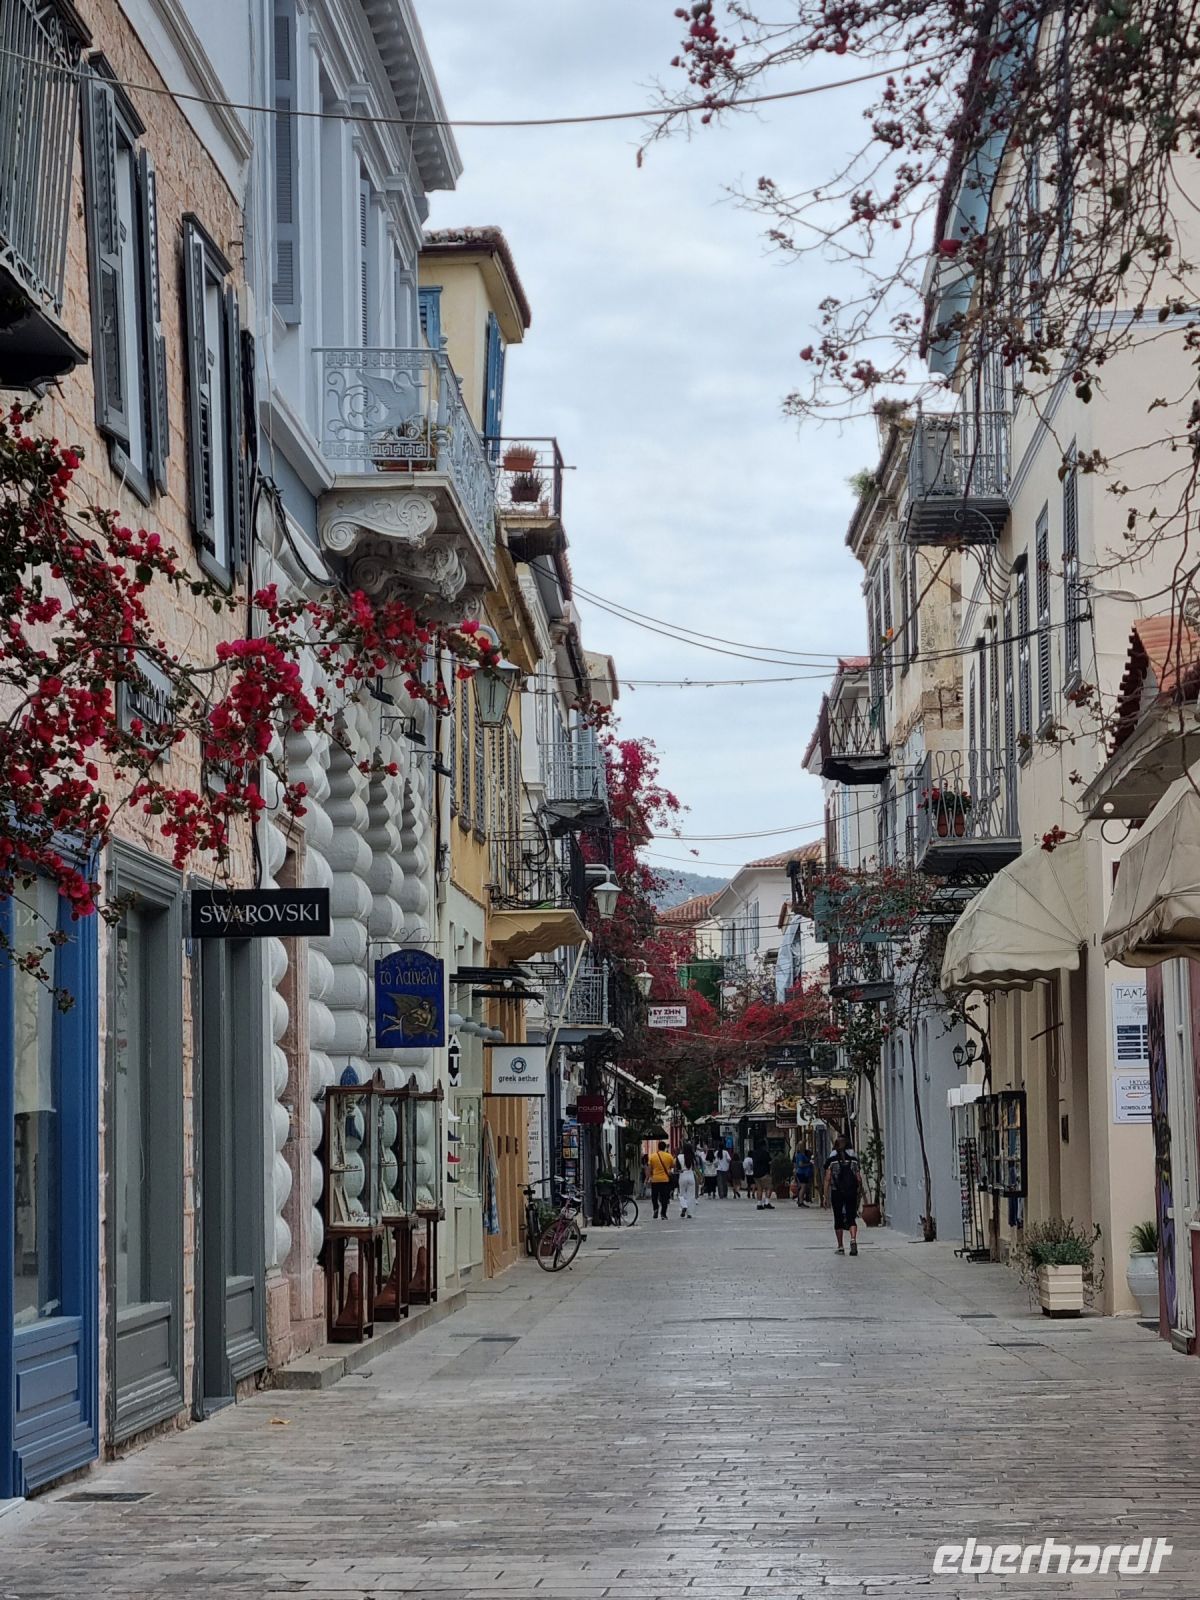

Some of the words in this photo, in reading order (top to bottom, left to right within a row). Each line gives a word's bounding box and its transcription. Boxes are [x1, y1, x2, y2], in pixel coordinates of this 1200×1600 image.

[200, 904, 319, 923] SWAROVSKI
[448, 1034, 462, 1087] ATM
[498, 1075, 516, 1083] greek
